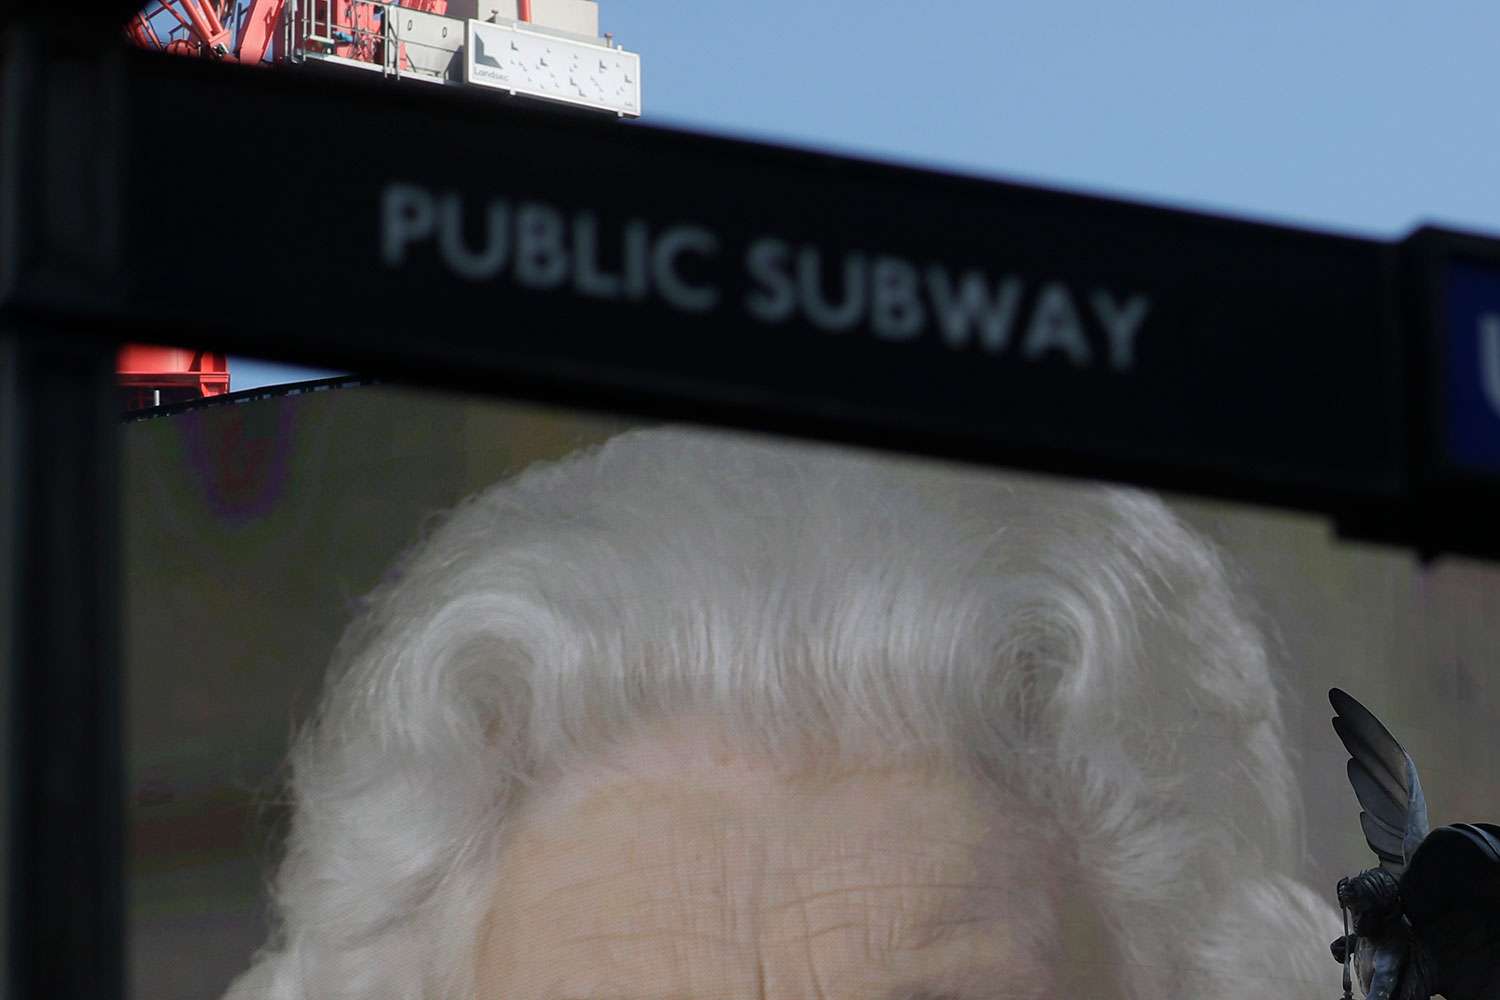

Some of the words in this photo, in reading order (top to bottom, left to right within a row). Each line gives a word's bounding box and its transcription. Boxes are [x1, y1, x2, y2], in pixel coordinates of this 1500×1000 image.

[473, 67, 509, 81] Landsec
[382, 184, 720, 312] PUBLIC
[746, 237, 1151, 369] SUBWAY
